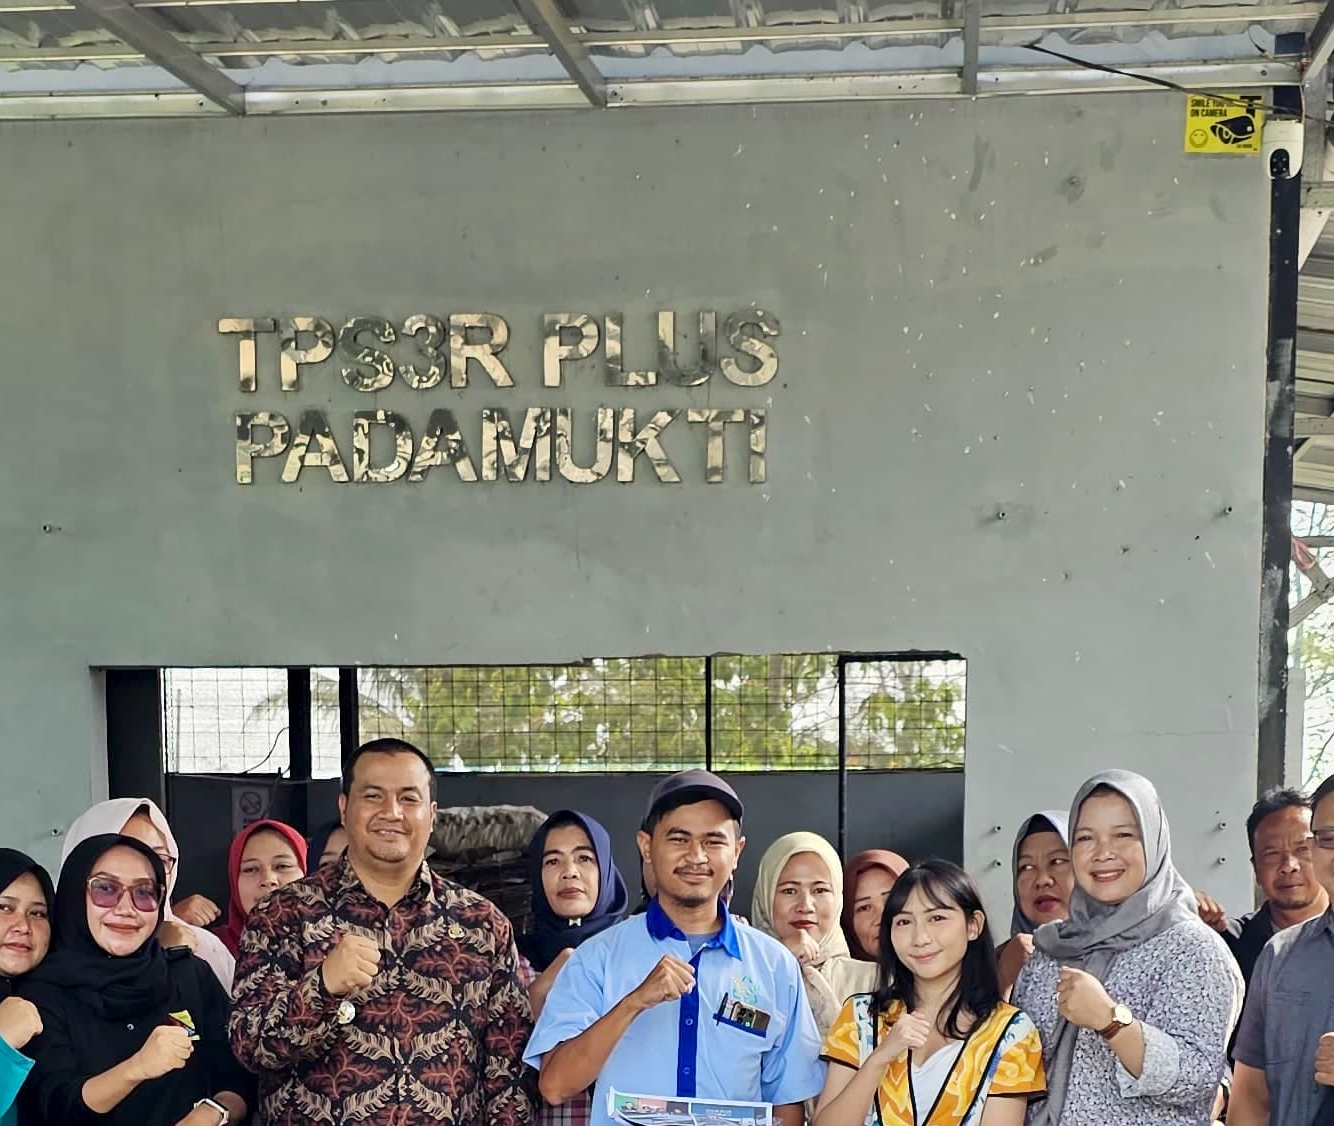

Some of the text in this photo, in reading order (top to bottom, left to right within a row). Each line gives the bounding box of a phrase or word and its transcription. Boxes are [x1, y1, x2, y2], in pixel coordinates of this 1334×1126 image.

[218, 308, 780, 393] TPS3R PLUS
[235, 406, 766, 485] PADAMUKTI
